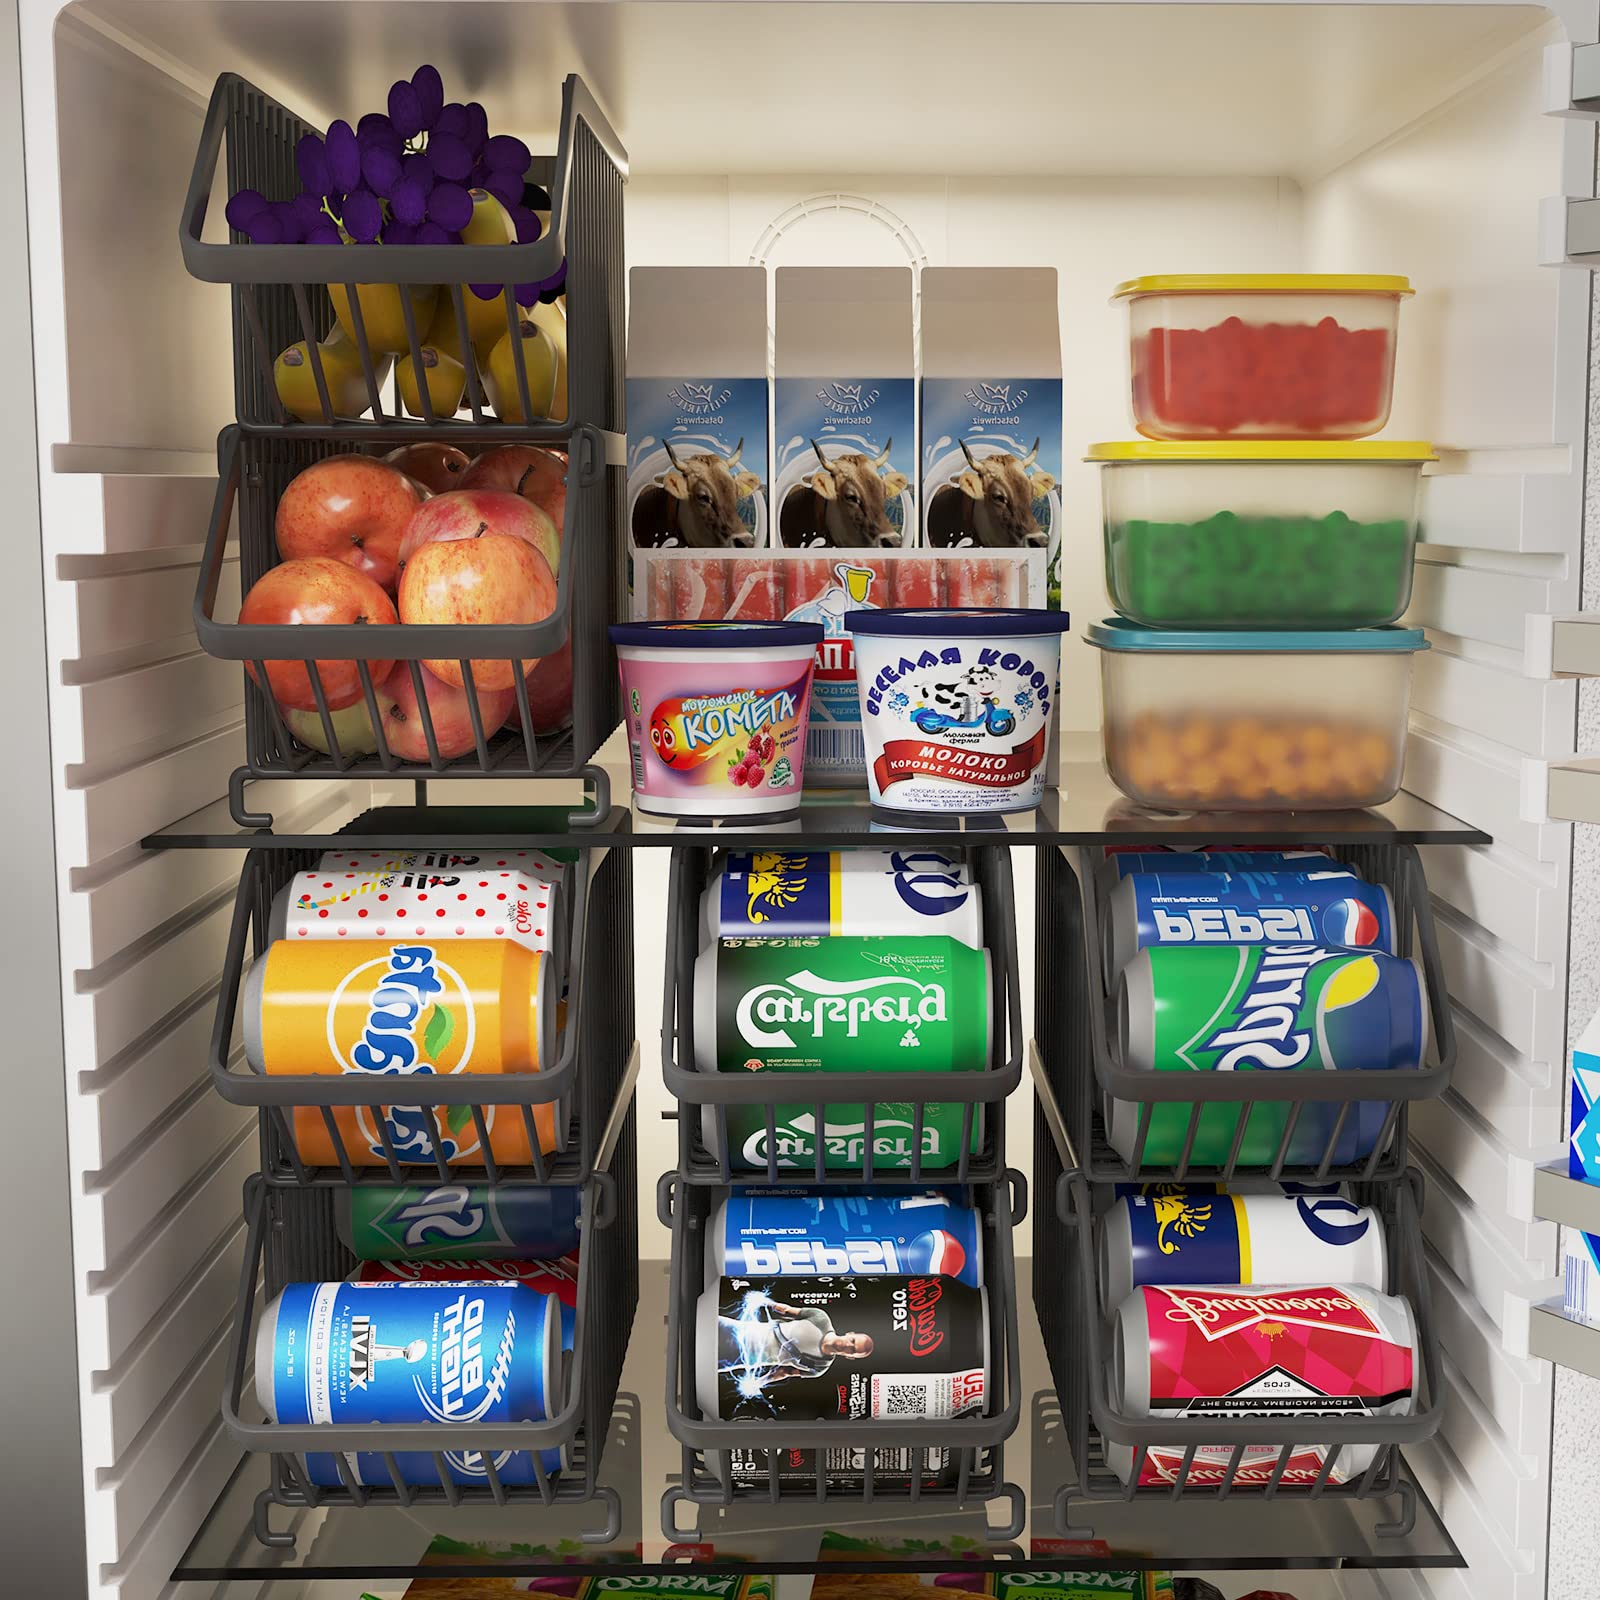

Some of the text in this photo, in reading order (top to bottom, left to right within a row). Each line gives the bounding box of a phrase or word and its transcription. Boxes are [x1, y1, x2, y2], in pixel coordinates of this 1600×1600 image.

[866, 647, 1051, 717] ВЕСЕЛАЯ КОРОВА
[681, 690, 757, 716] мороженое
[683, 690, 797, 750] КОМЕТА
[918, 746, 1008, 770] МОЛОКО
[890, 760, 945, 773] КОРОВЬЕ
[949, 767, 1026, 783] НАТУРАЛЬНОЕ
